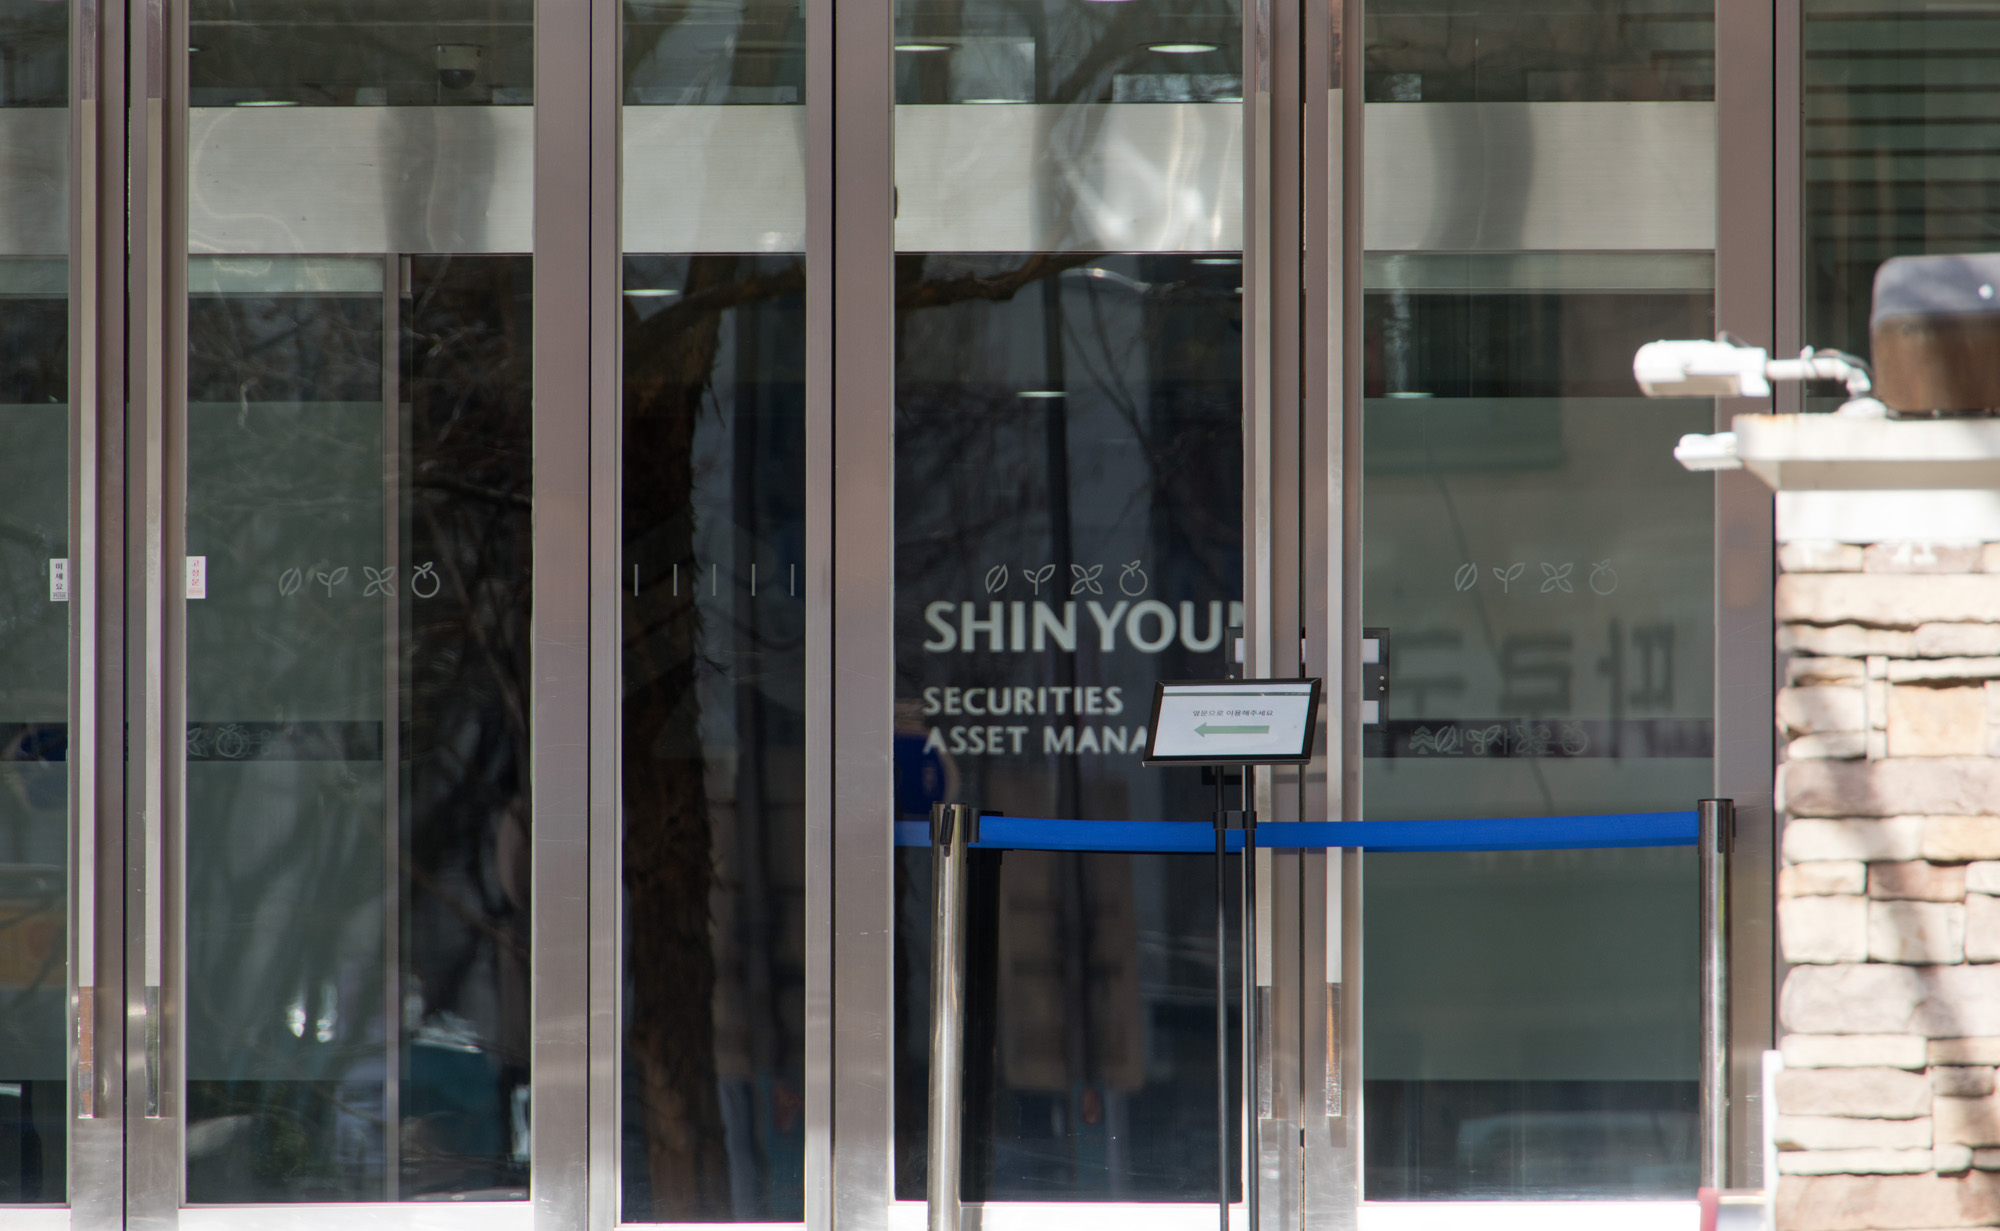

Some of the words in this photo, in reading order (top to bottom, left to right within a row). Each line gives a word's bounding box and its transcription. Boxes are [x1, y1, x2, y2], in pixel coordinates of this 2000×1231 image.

[924, 686, 1124, 715] SECURITIES
[1192, 709, 1224, 718] 옆문으로
[1226, 709, 1275, 718] 이용해주세요
[923, 726, 1028, 755] ASSET
